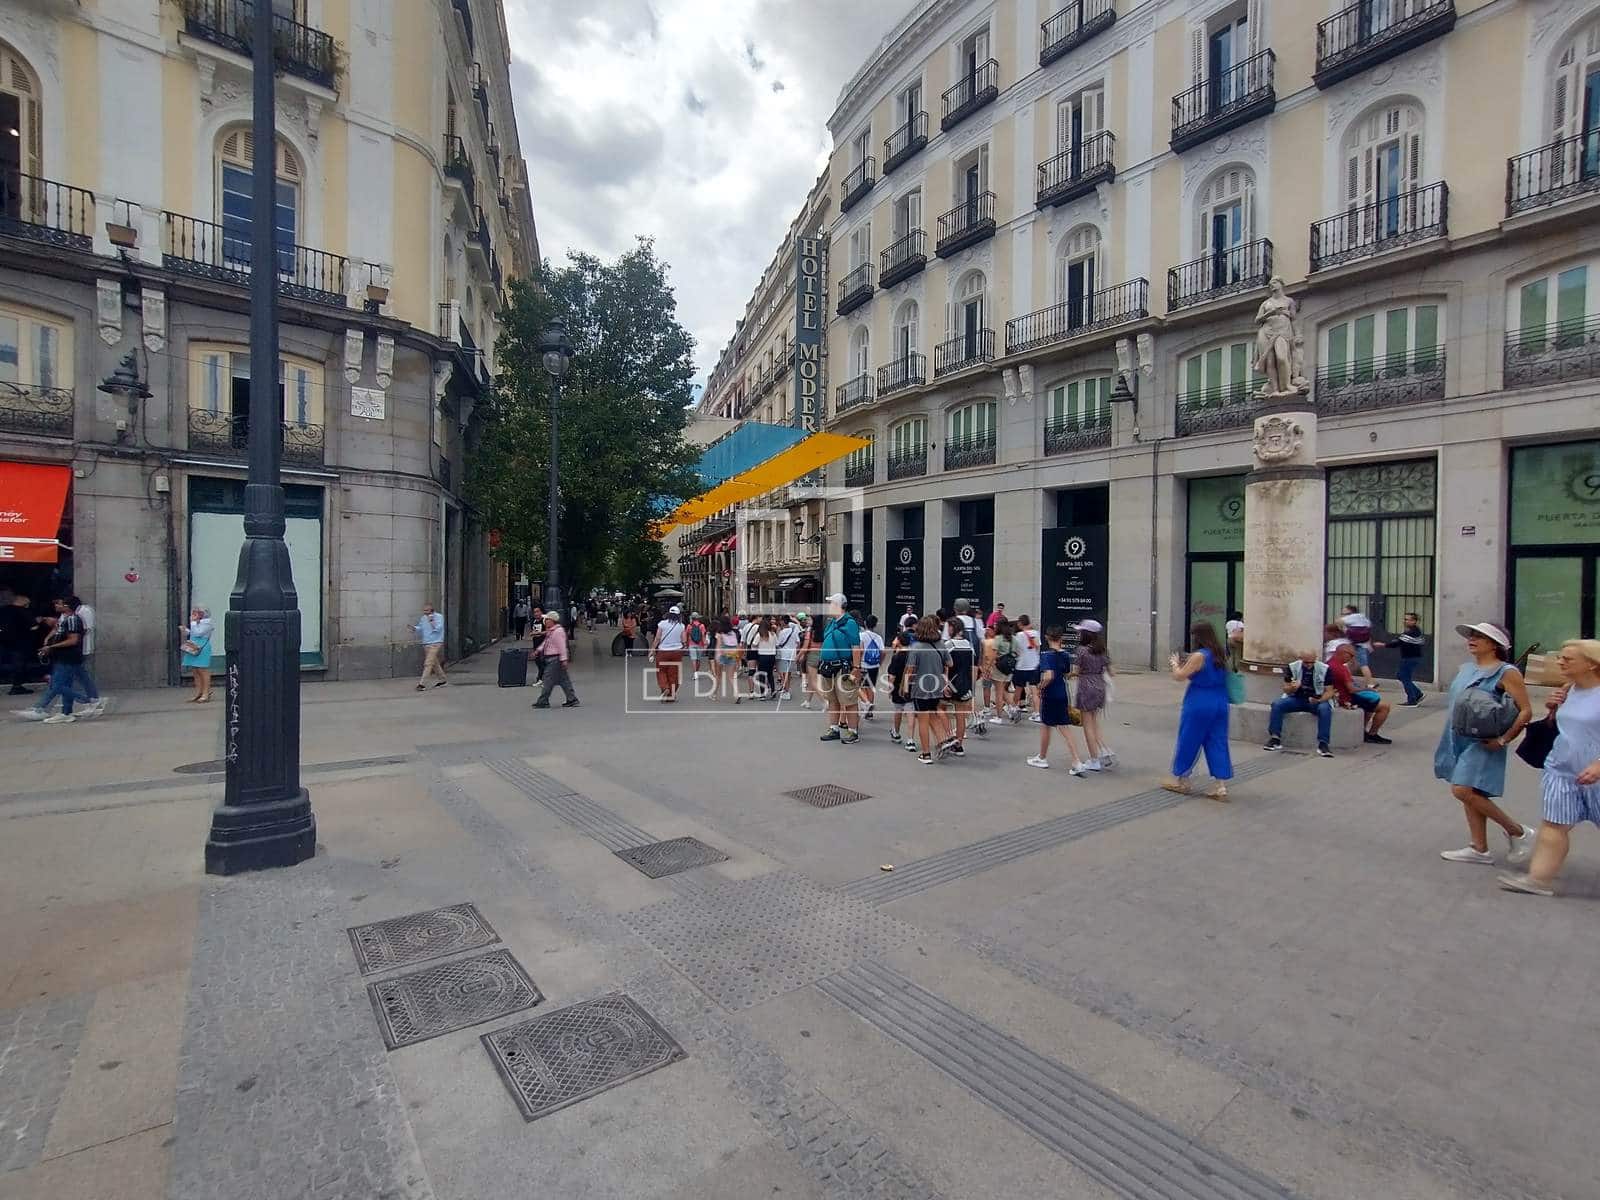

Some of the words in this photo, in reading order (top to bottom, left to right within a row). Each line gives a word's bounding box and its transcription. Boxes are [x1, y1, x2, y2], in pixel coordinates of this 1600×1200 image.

[802, 238, 819, 330] HOTEL
[799, 342, 818, 432] MODER
[1229, 500, 1240, 516] 9
[1071, 542, 1079, 554] 9
